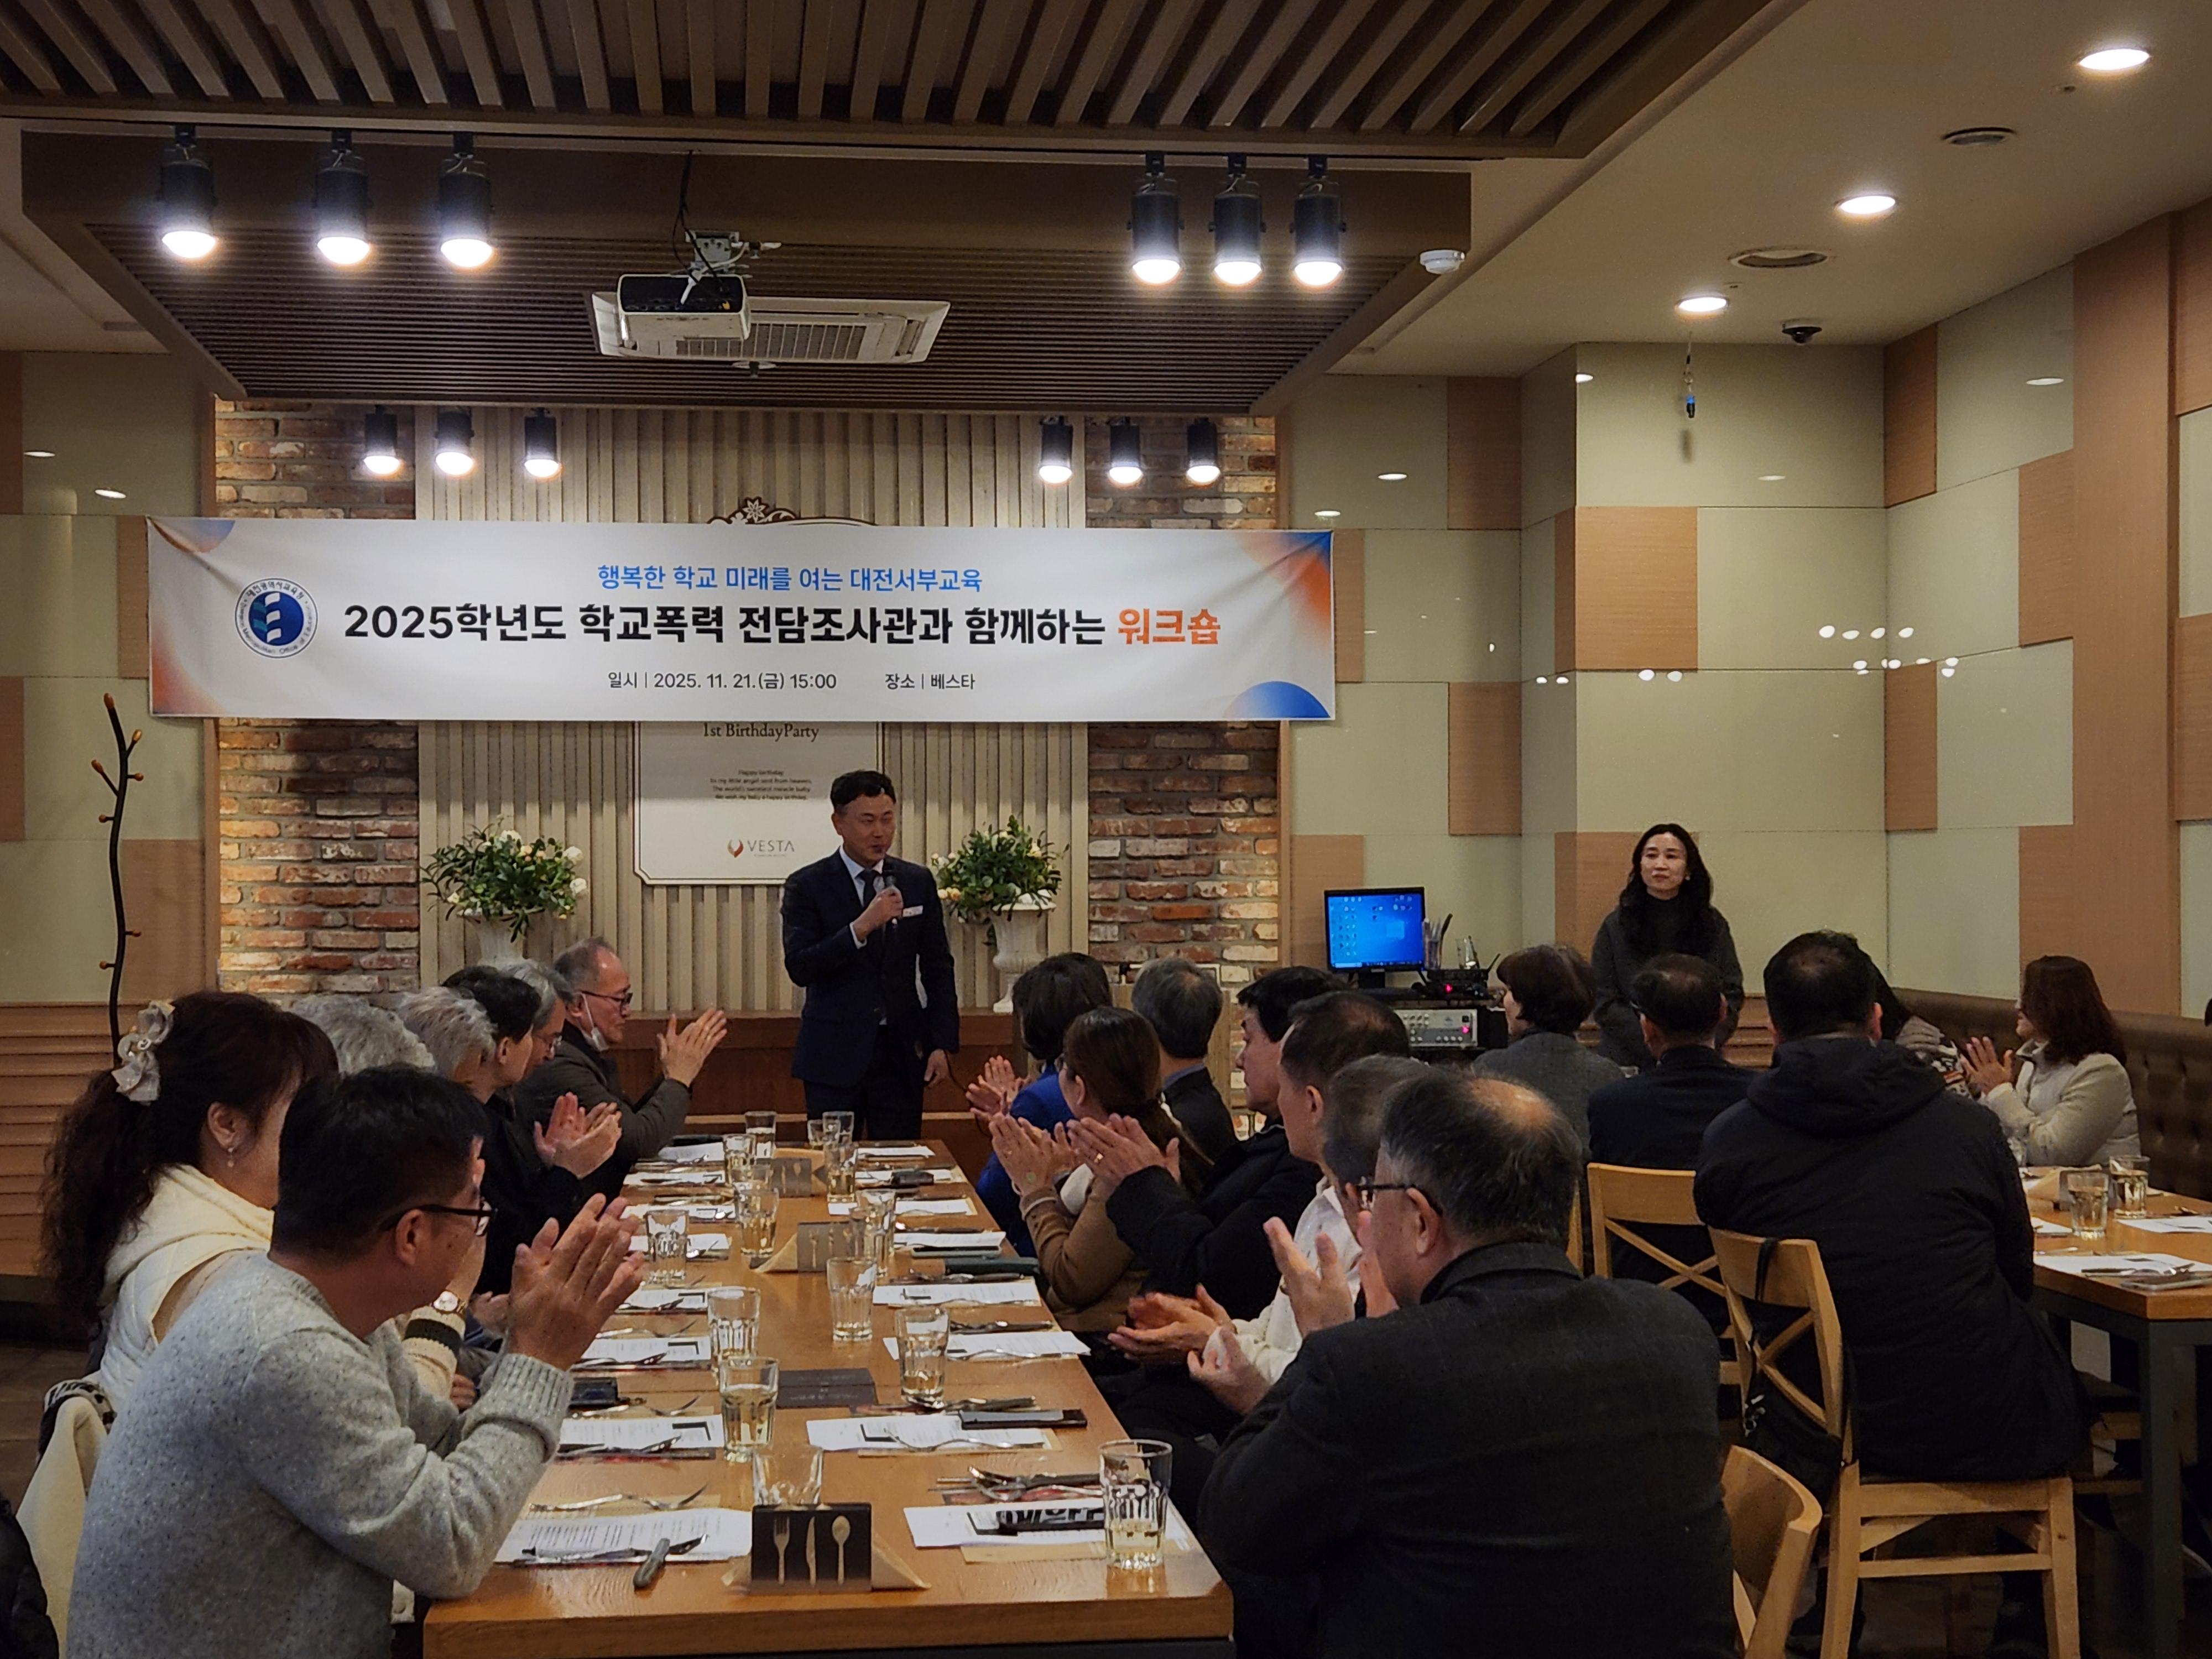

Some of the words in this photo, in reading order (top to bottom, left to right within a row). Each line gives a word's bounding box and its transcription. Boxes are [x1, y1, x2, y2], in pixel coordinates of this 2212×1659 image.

[598, 565, 665, 590] 행복한
[674, 566, 716, 589] 학교
[726, 568, 790, 591] 미래를
[800, 569, 842, 591] 여는
[850, 568, 982, 592] 대전서부교육
[345, 603, 566, 641] 2025학년도
[579, 604, 724, 643] 학교폭력
[739, 606, 953, 644] 전담조사관과
[964, 607, 1105, 645] 함께하는
[1118, 609, 1220, 645] 워크숍
[608, 672, 638, 688] 일시
[654, 673, 701, 688] 2025.
[790, 674, 837, 689] 15:00
[885, 673, 915, 690] 장소
[931, 674, 976, 690] 베스타
[703, 722, 722, 737] 1st
[747, 840, 795, 852] VESTA
